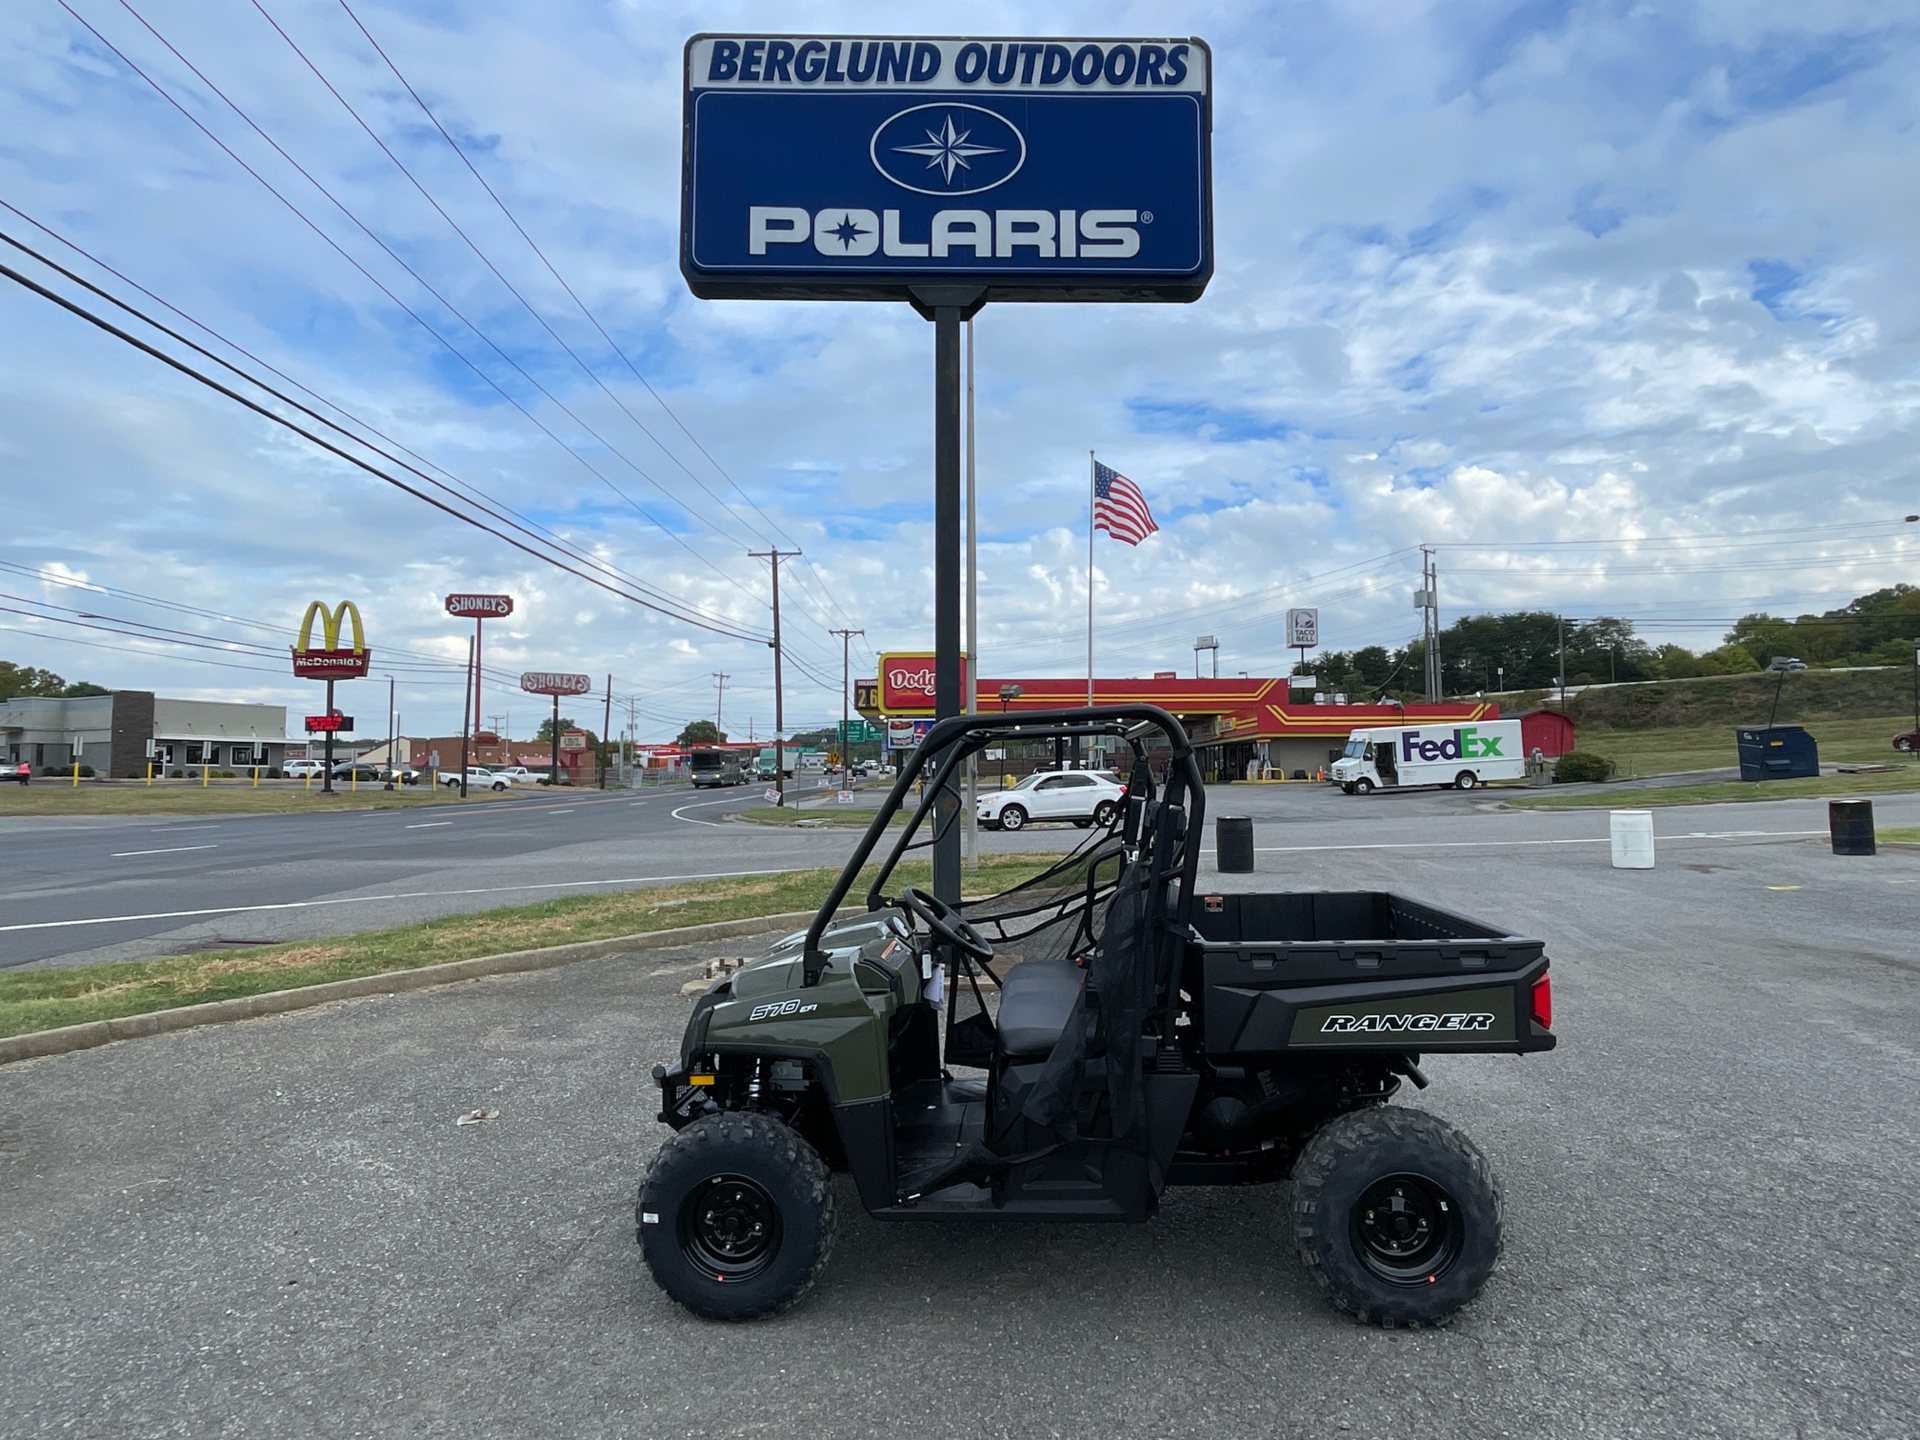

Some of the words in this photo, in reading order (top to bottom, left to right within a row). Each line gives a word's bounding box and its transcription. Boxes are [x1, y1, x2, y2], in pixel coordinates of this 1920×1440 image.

[708, 38, 942, 84] BERGLUND
[954, 41, 1190, 87] OUTDOORS
[449, 596, 509, 613] SHONEY'S
[296, 657, 363, 667] McDonald's
[526, 673, 589, 691] SHONEY'S
[888, 668, 936, 696] Dodg
[857, 688, 878, 707] 2.6
[1402, 727, 1504, 762] FedEx
[749, 999, 801, 1021] 570
[1320, 1012, 1495, 1033] RANGER
